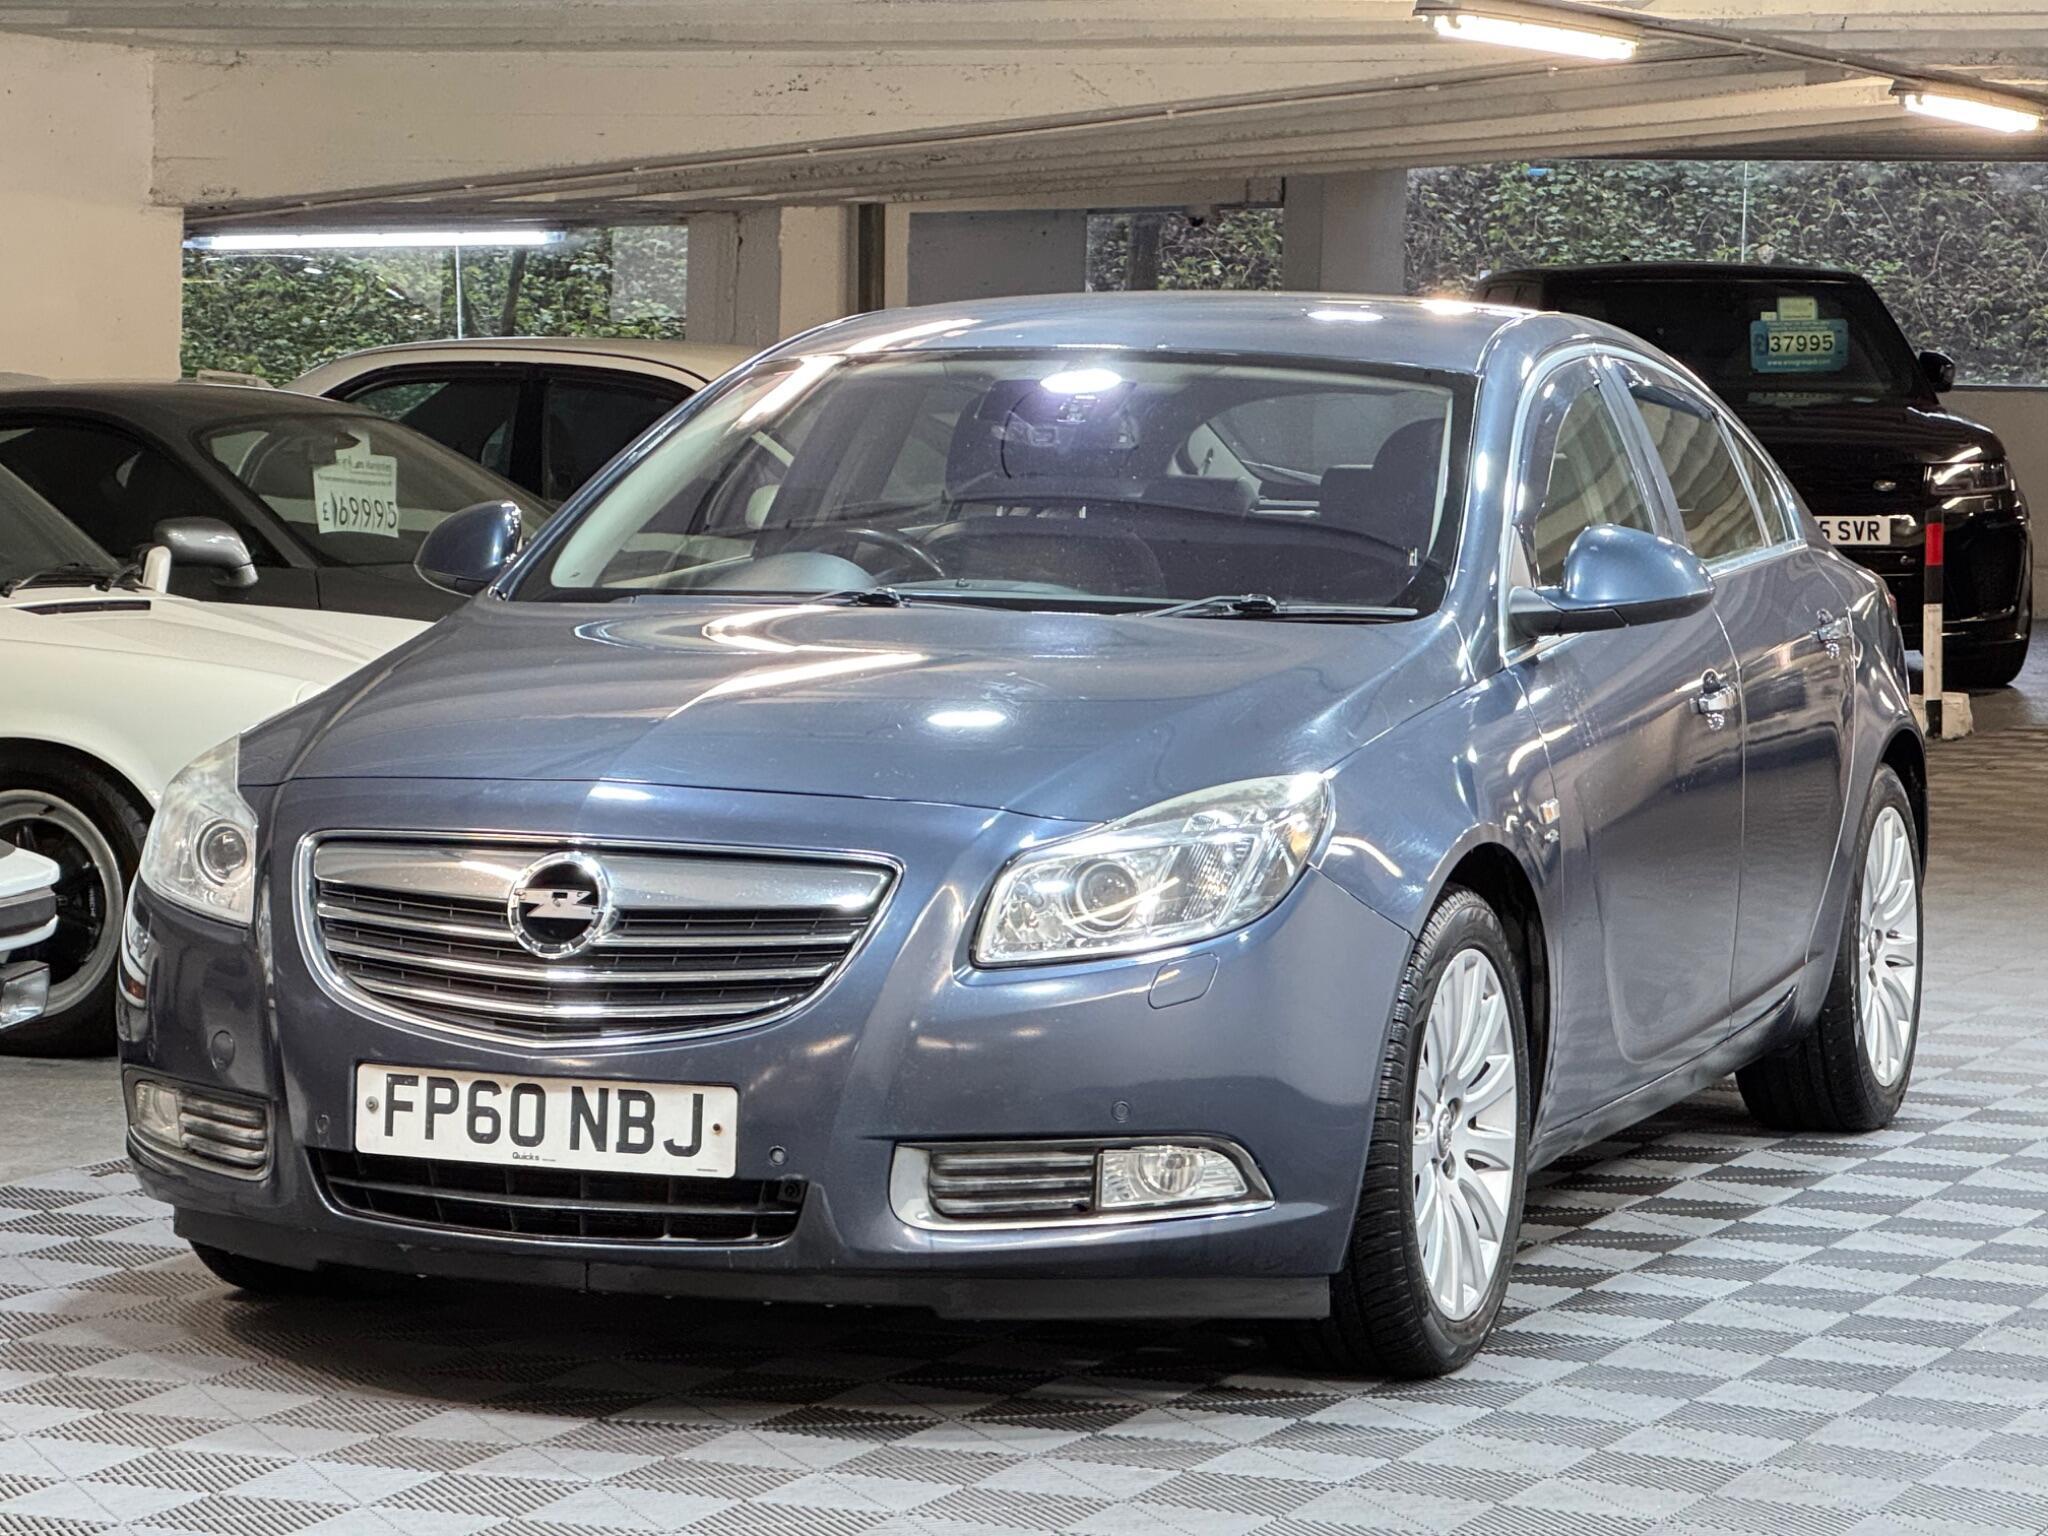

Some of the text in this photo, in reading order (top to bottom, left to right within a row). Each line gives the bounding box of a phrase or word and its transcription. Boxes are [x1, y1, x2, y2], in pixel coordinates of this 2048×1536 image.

[1838, 520, 1881, 542] SVR
[383, 1073, 704, 1158] FP60 NBJ
